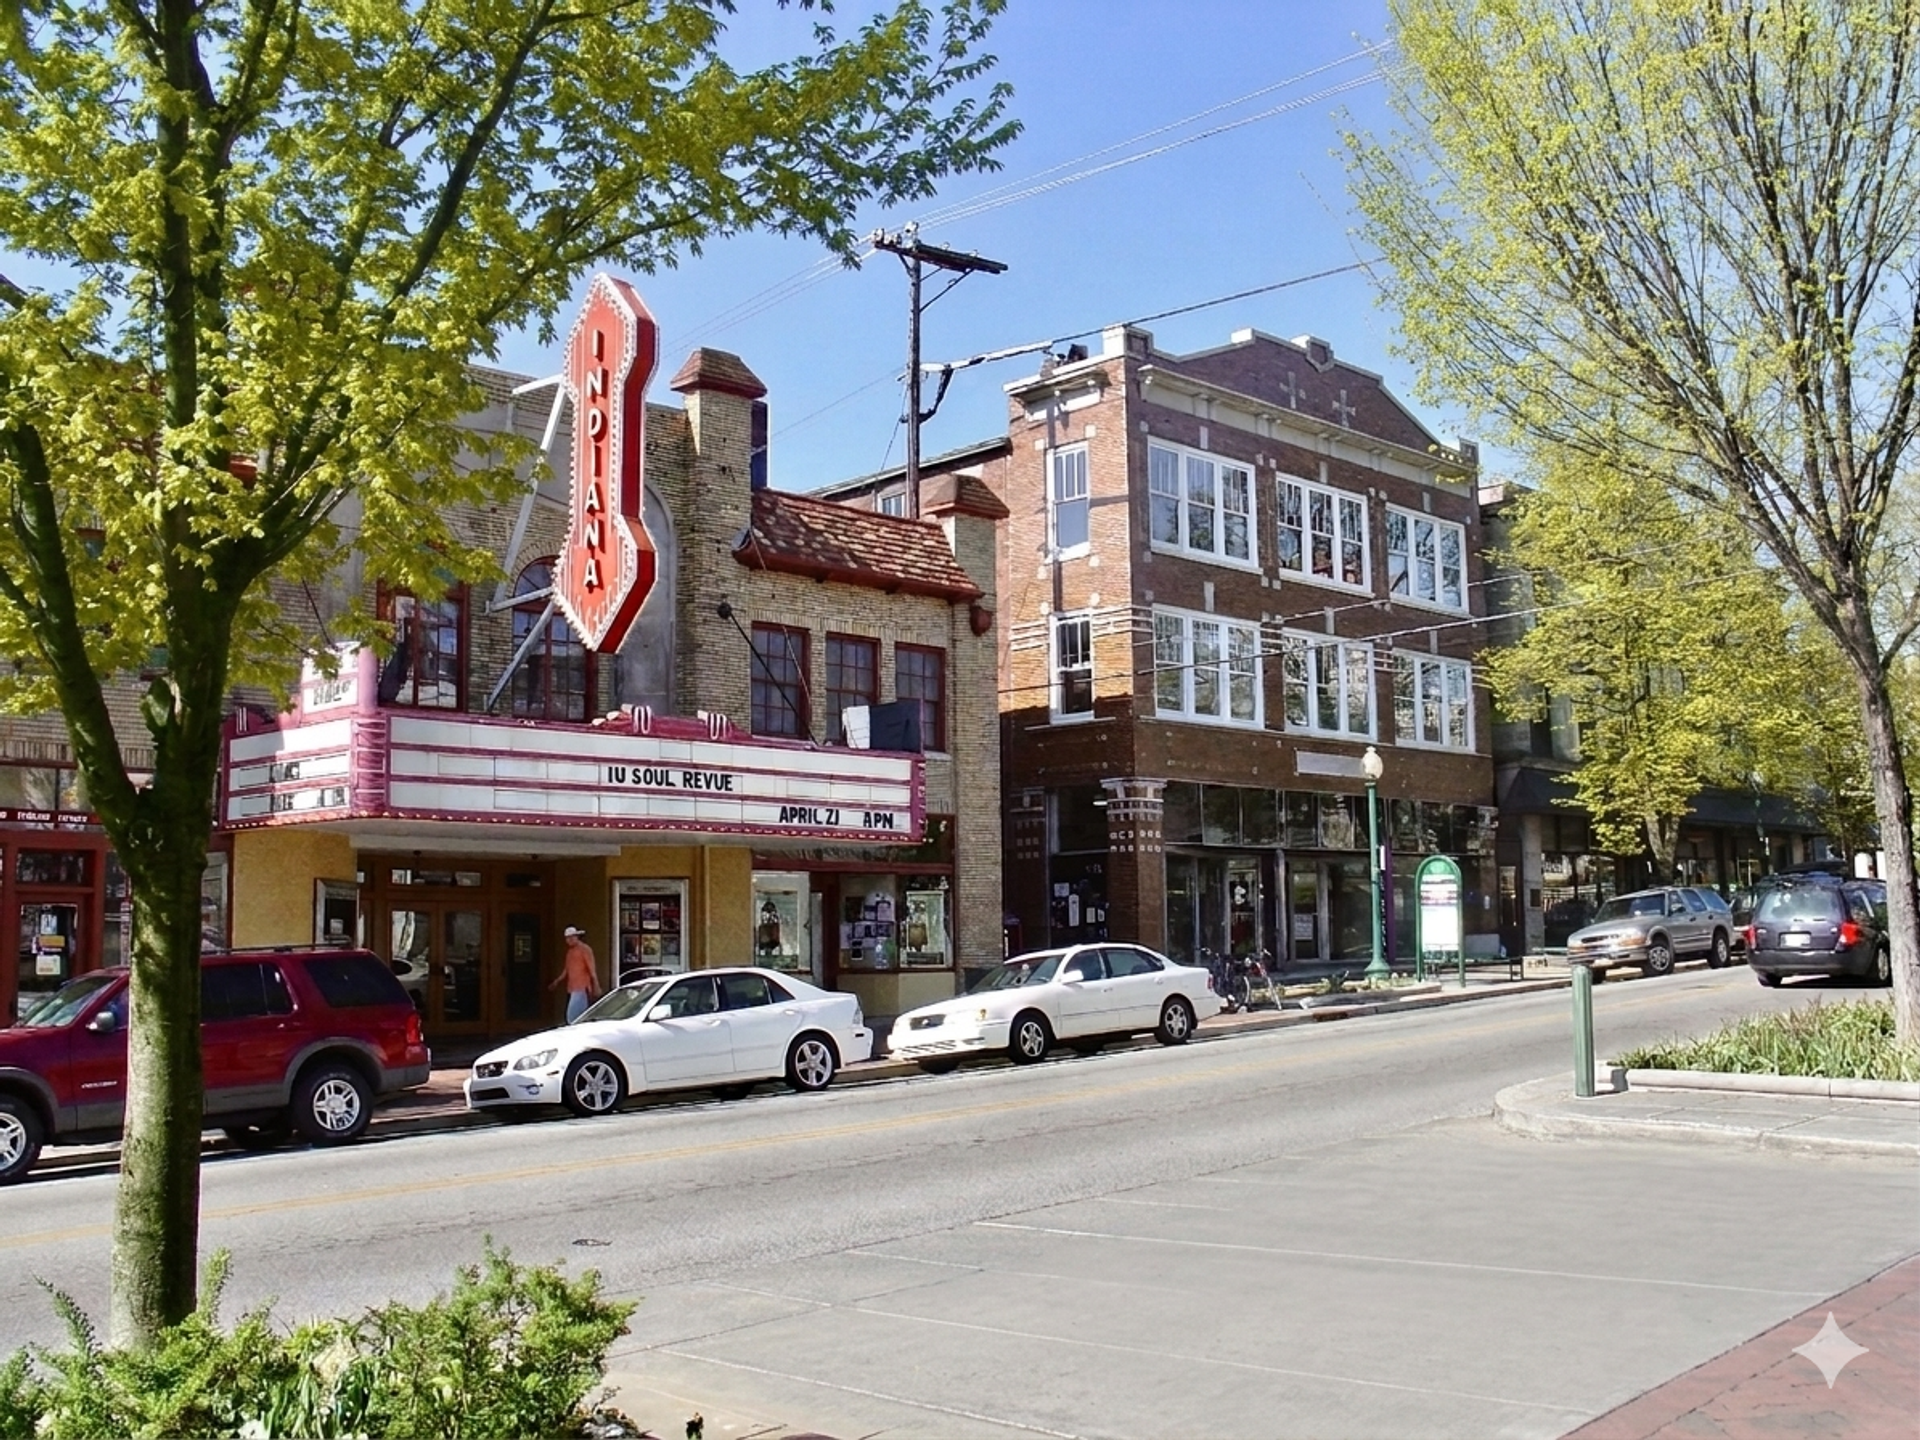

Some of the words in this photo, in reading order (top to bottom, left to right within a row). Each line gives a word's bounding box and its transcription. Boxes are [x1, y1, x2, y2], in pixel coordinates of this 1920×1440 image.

[583, 329, 605, 588] INDIANA
[608, 766, 626, 784] IU
[631, 768, 676, 787] SOUL
[682, 771, 733, 791] REVUE
[779, 806, 823, 825] APRIL
